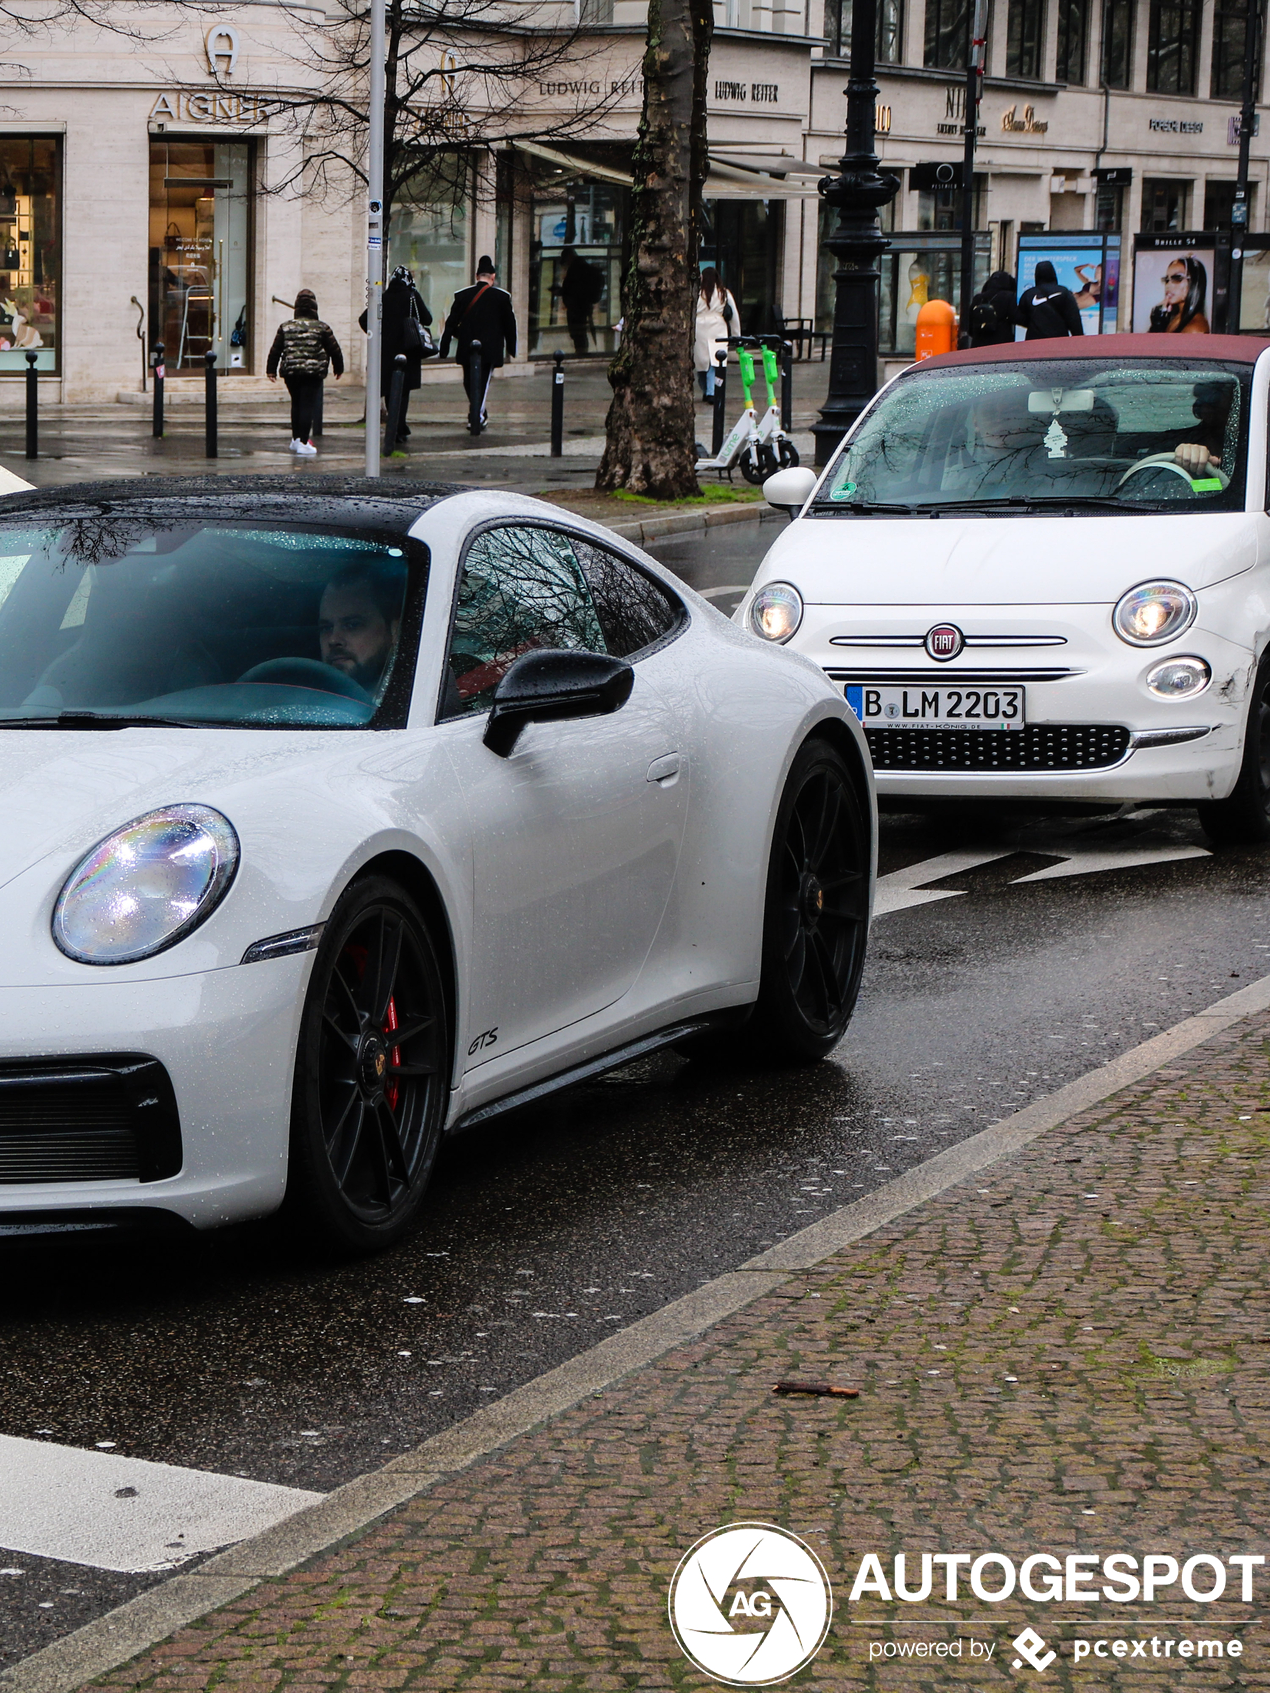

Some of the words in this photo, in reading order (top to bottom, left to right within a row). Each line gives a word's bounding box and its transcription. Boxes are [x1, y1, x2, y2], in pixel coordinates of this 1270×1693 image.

[539, 81, 600, 96] LUDWIG
[715, 80, 746, 100] LUDWIG
[751, 84, 778, 102] REITER
[149, 94, 270, 121] AIGNER
[934, 635, 953, 650] FIAT
[865, 690, 882, 716] B
[902, 691, 939, 718] LM
[946, 691, 1019, 719] 2203
[468, 1026, 498, 1056] GTS
